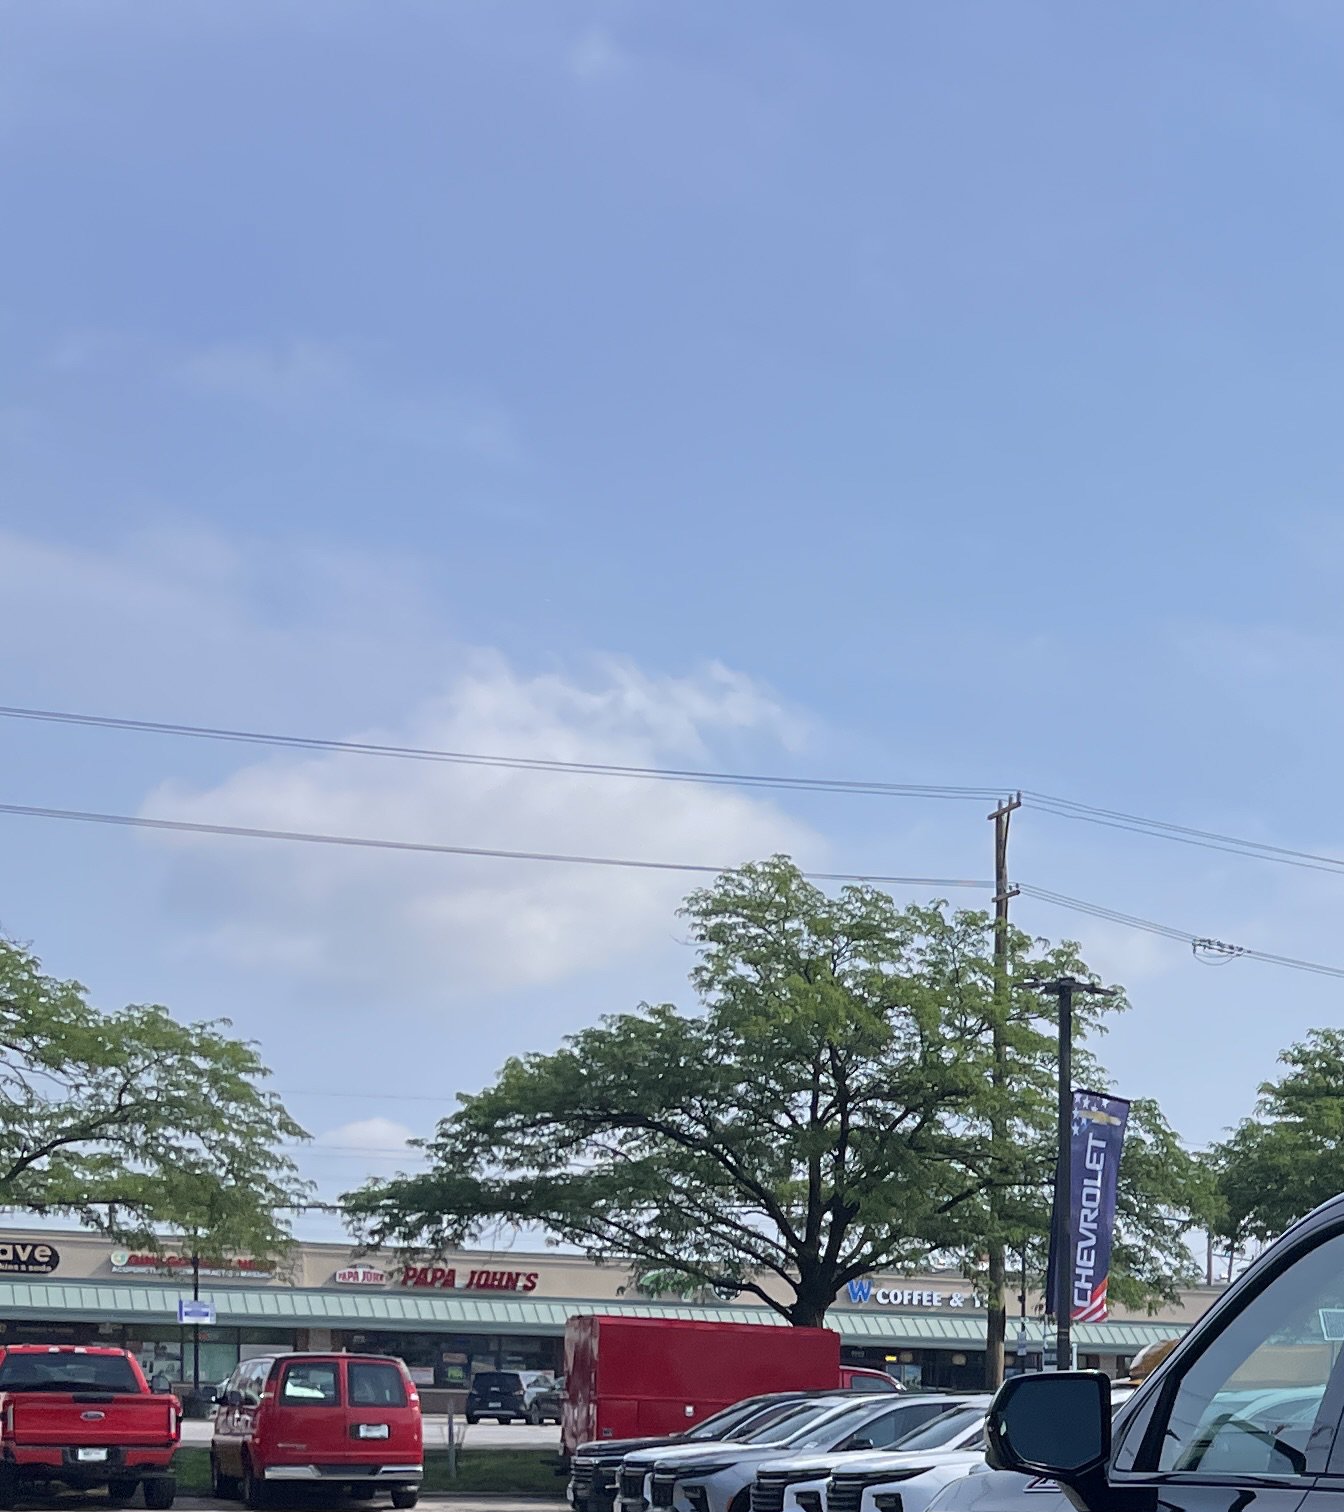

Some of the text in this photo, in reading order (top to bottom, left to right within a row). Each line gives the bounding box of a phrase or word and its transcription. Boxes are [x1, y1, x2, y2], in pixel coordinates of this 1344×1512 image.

[1073, 1132, 1107, 1308] CHEVROLET
[402, 1266, 539, 1292] PAPA JOHN'S
[847, 1280, 873, 1304] W
[876, 1288, 943, 1307] COFFEE
